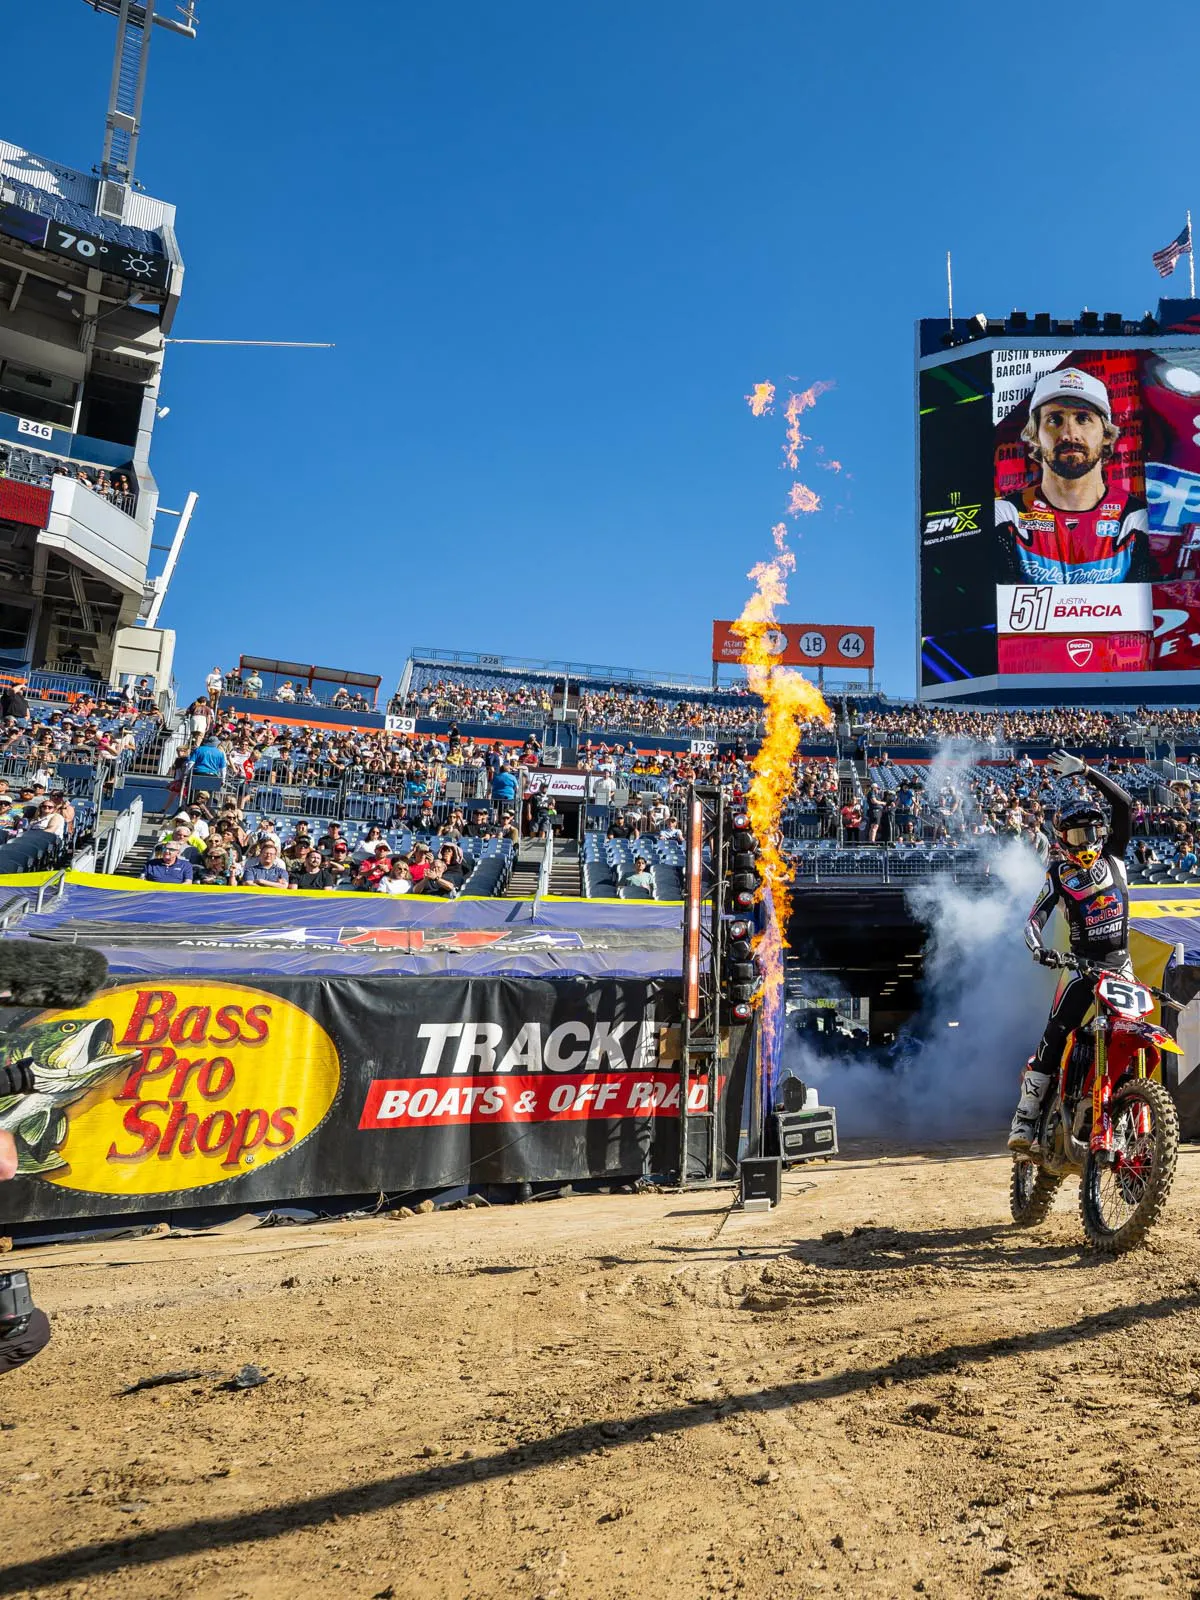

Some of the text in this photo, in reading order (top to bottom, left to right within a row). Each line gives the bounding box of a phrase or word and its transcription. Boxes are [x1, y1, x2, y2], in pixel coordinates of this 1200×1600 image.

[54, 168, 77, 182] 542
[997, 350, 1030, 363] JUSTIN
[996, 362, 1032, 378] BARCIA
[20, 419, 51, 438] 346
[924, 509, 979, 535] SMX
[1097, 521, 1119, 536] PPG
[1009, 586, 1053, 631] 51
[1056, 597, 1088, 605] JUSTIN
[1053, 604, 1123, 618] BARCIA
[804, 637, 823, 652] 18
[842, 638, 861, 653] 44
[482, 656, 499, 666] 228
[388, 717, 412, 731] 129
[551, 783, 586, 791] BARCIA
[1085, 903, 1124, 927] Red Bull
[1088, 920, 1122, 937] DUCATI
[177, 940, 306, 949] AMERICAN
[1106, 982, 1147, 1014] 51
[116, 990, 272, 1047] Bass
[113, 1046, 235, 1102] Pro
[378, 1081, 709, 1121] BOATS & OFF ROAD
[106, 1099, 298, 1169] Shops
